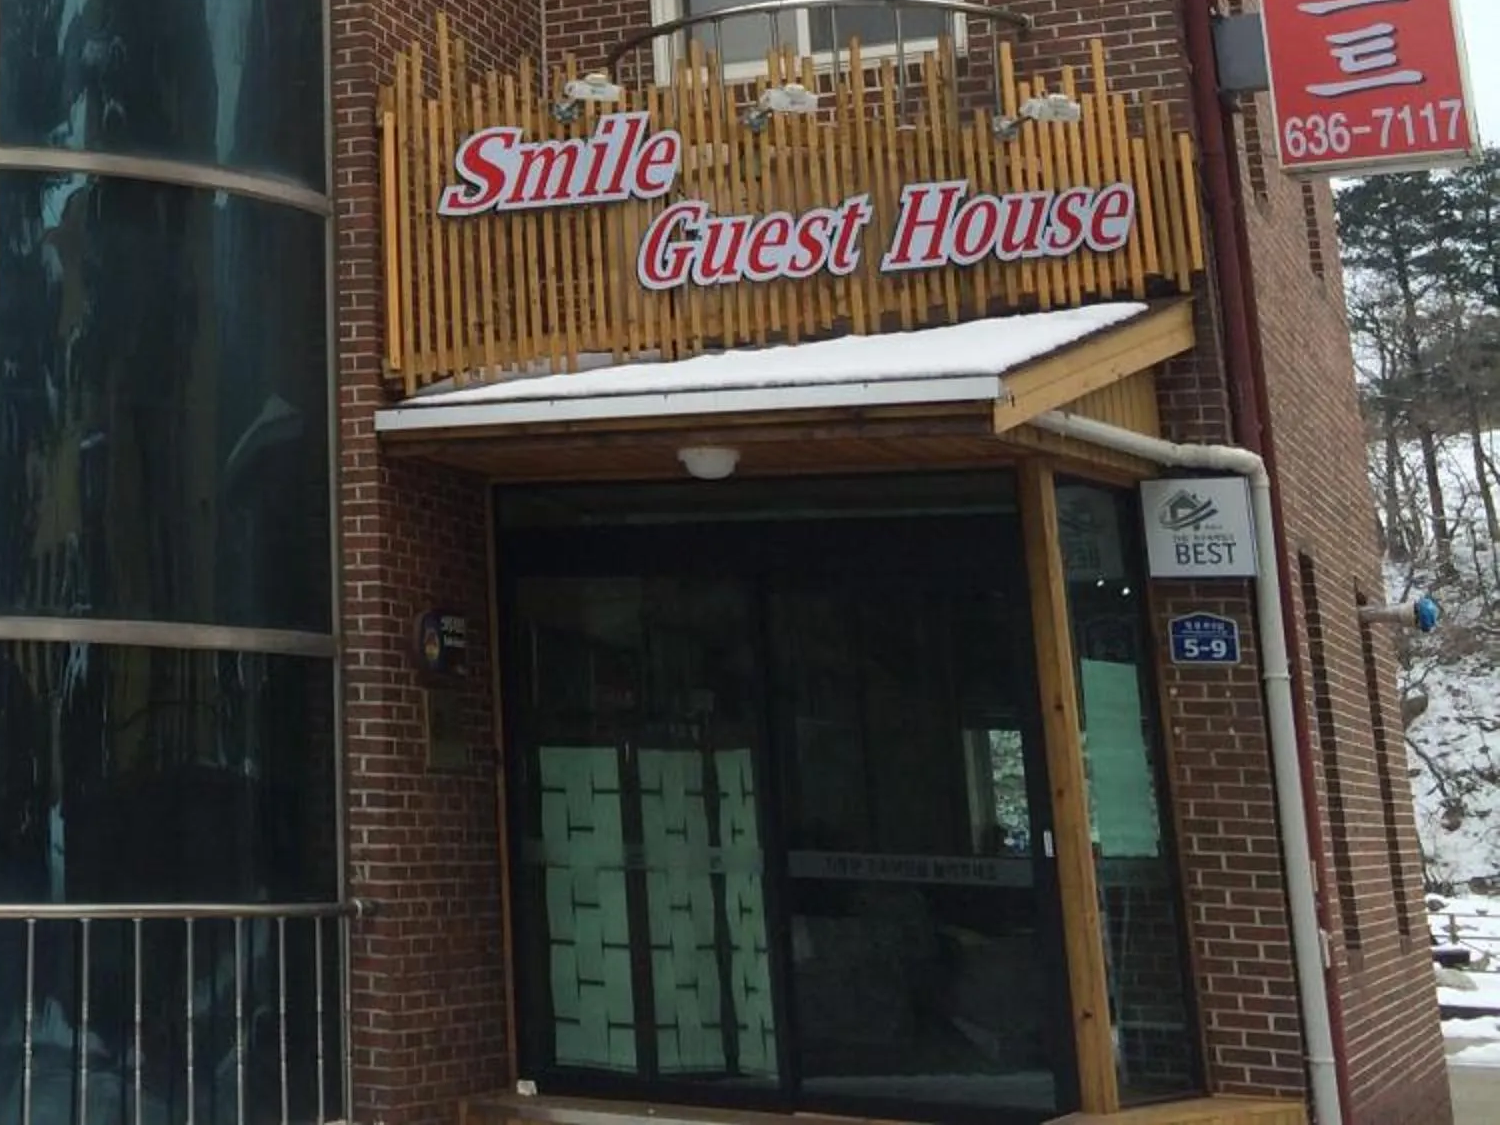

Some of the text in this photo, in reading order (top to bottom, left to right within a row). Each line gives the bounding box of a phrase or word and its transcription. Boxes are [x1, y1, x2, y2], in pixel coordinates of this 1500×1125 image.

[1285, 99, 1461, 158] 636-7117
[441, 113, 680, 215] Smile
[640, 181, 1134, 288] Guest House
[1175, 542, 1237, 565] BEST
[1184, 639, 1227, 658] 5-9
